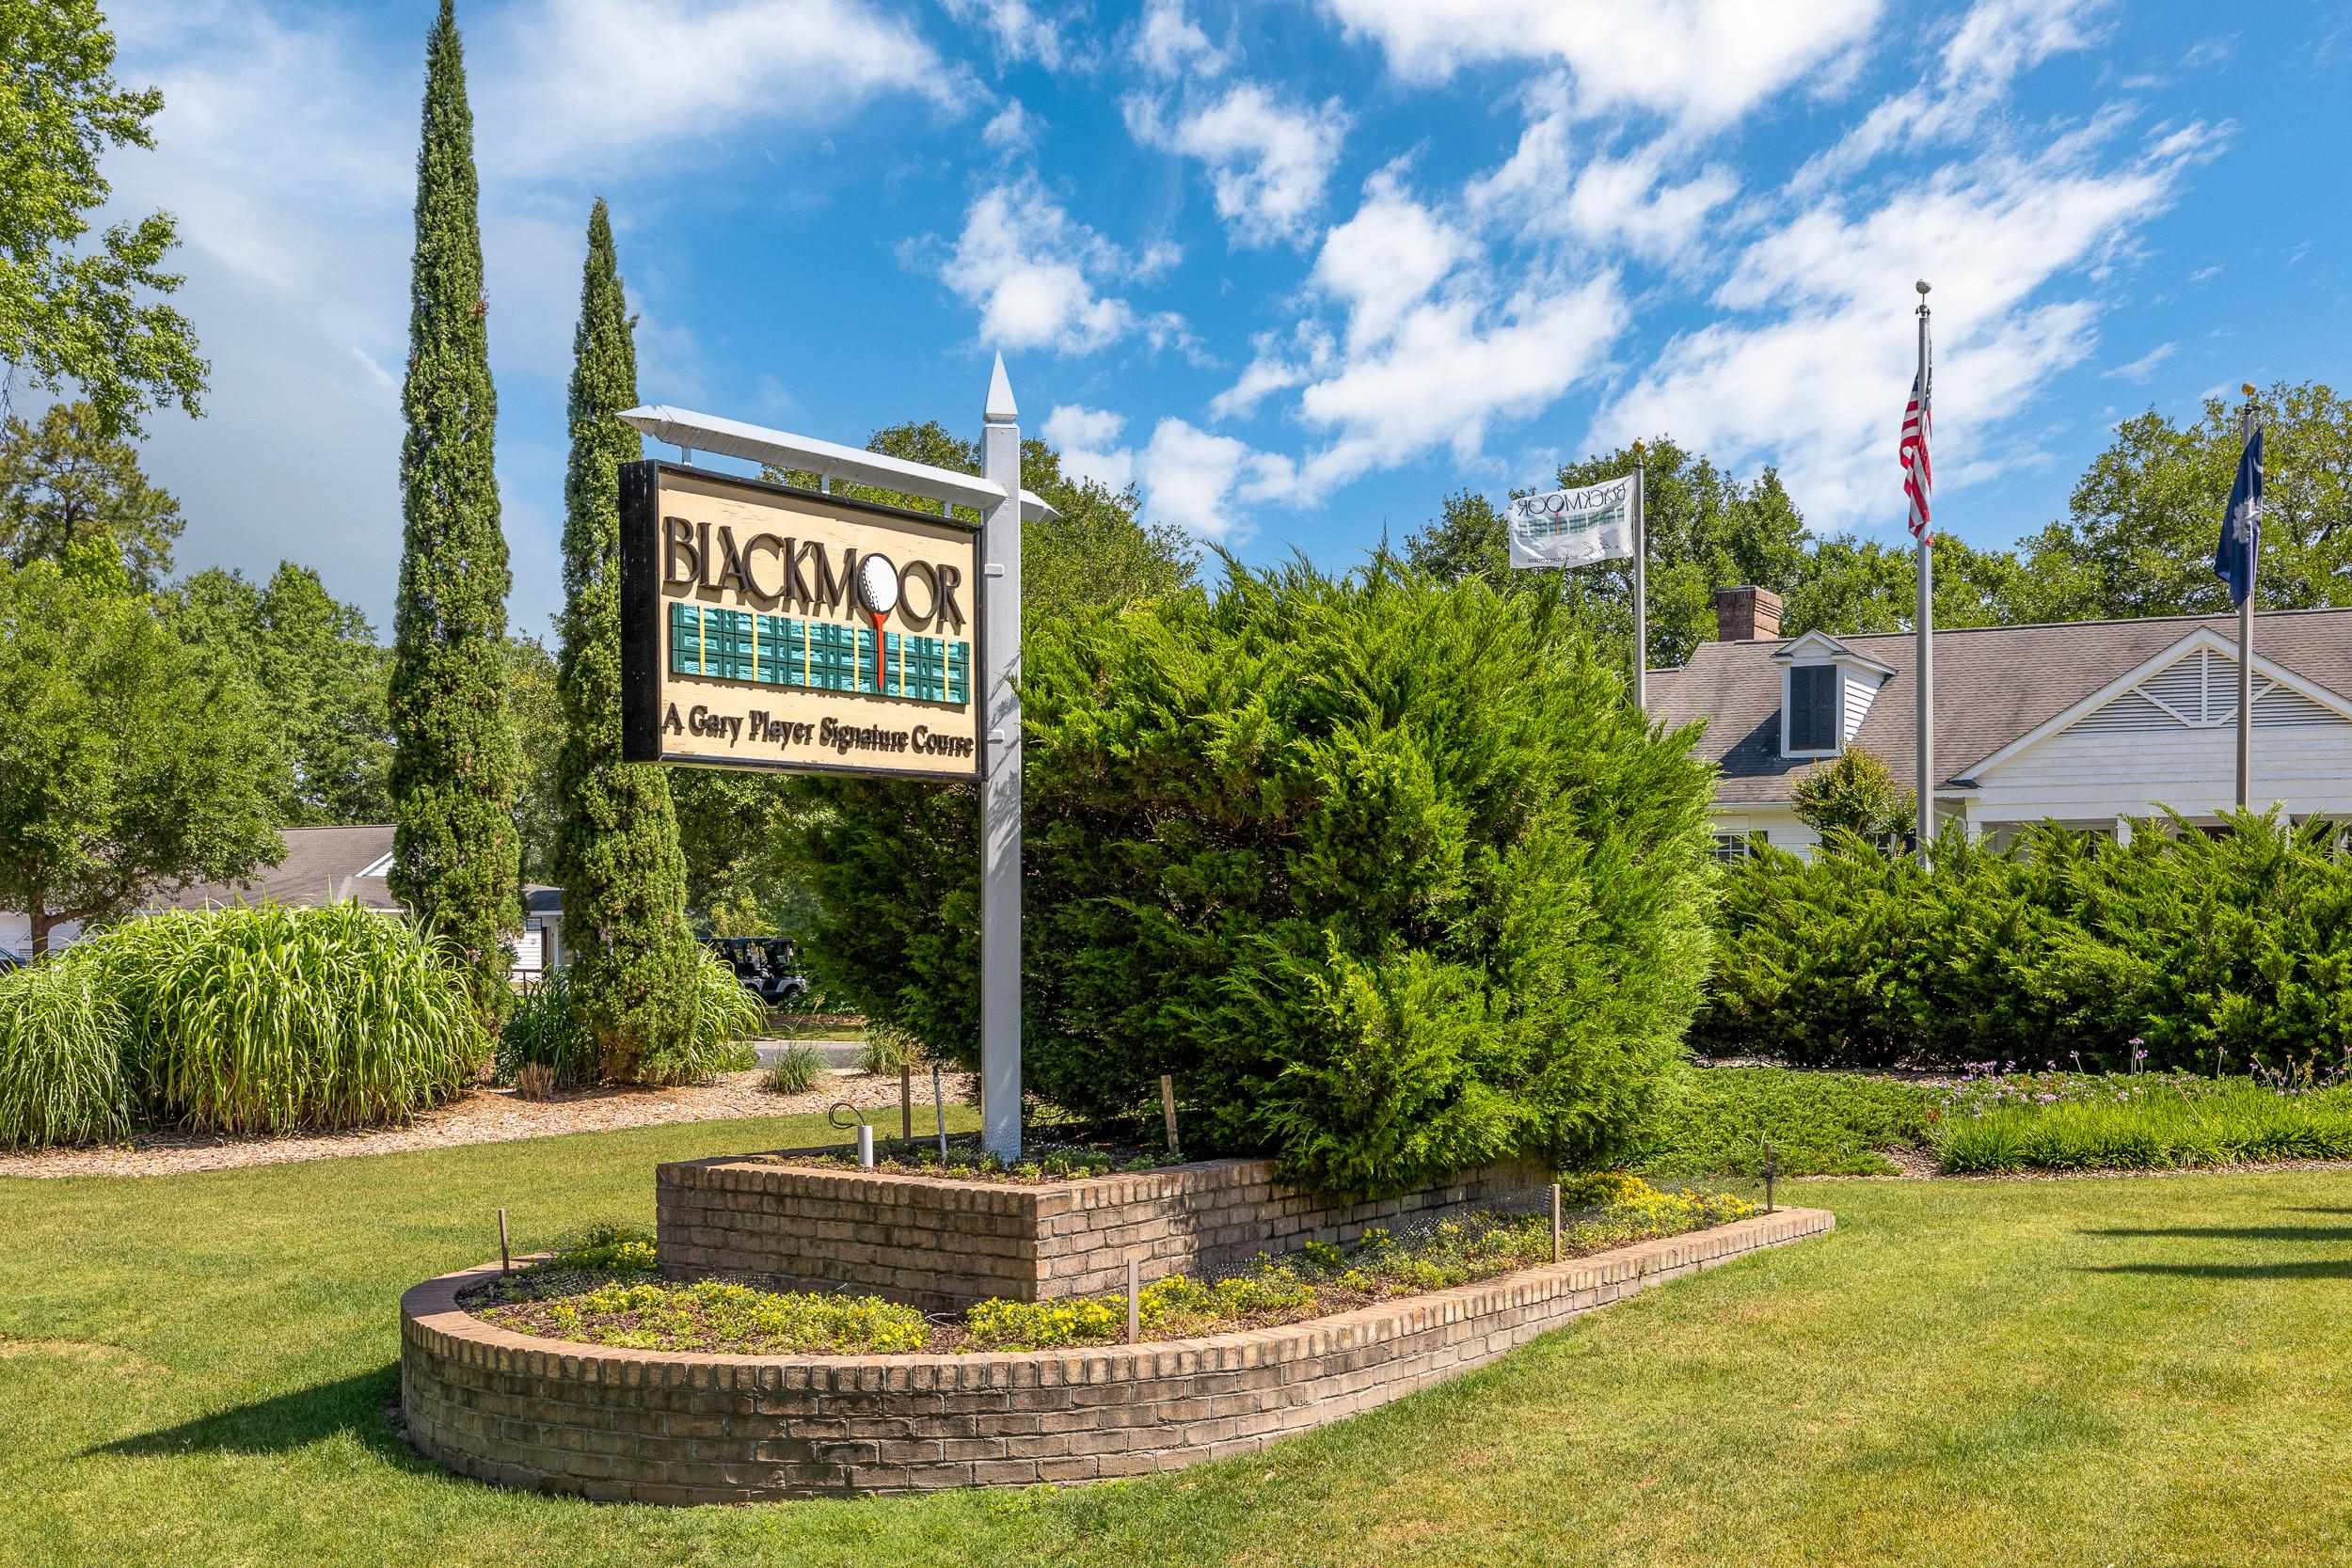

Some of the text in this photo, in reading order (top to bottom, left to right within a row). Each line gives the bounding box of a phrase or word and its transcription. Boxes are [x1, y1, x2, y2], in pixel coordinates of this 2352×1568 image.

[662, 515, 966, 628] BLACKMOOR
[661, 702, 975, 758] A Gary Player Signature Course
